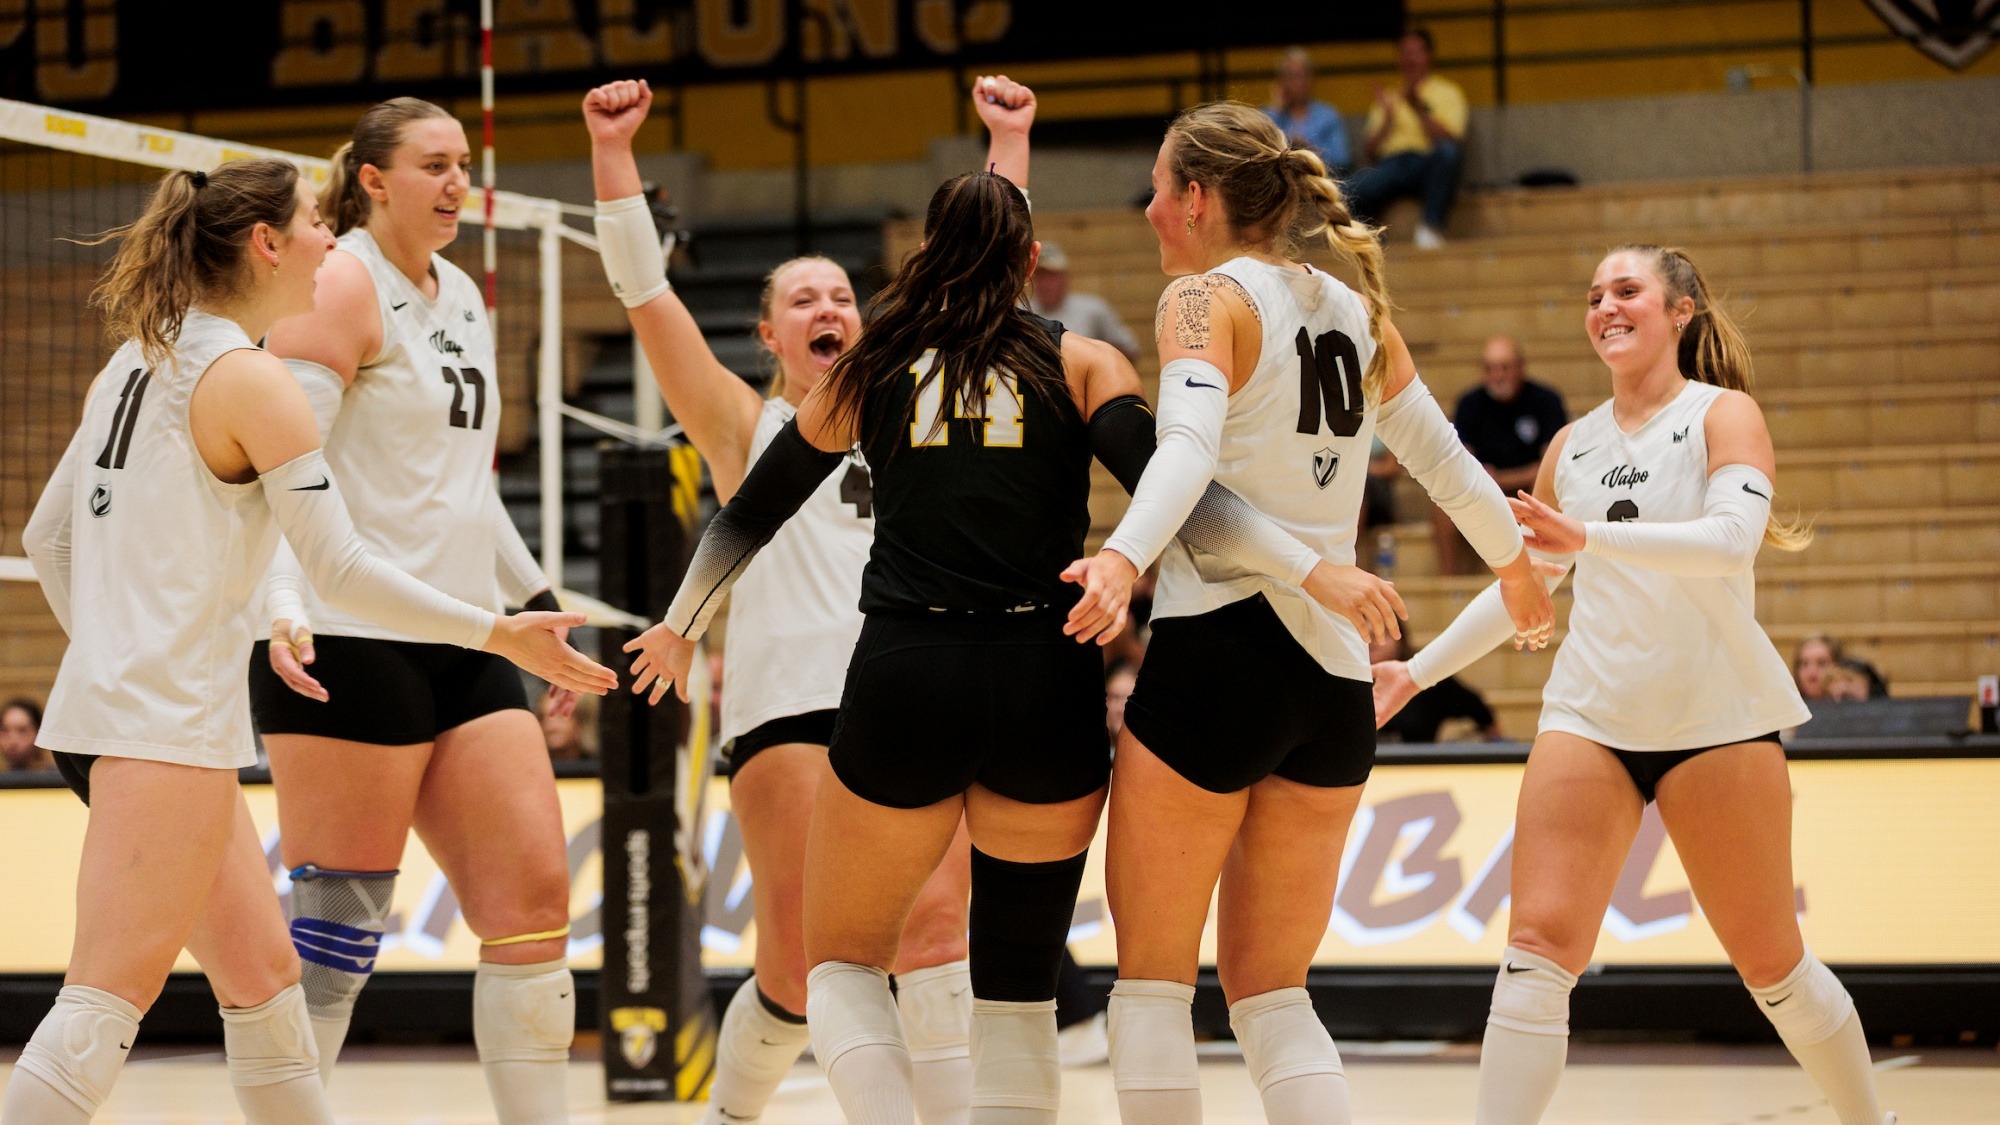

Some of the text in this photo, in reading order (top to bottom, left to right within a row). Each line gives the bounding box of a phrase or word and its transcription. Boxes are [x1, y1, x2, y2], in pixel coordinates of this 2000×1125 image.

[95, 368, 156, 469] 11
[441, 366, 486, 430] 27
[909, 347, 1024, 448] 14
[1295, 326, 1364, 437] 10
[840, 462, 874, 518] 4
[1601, 464, 1649, 490] Valpo
